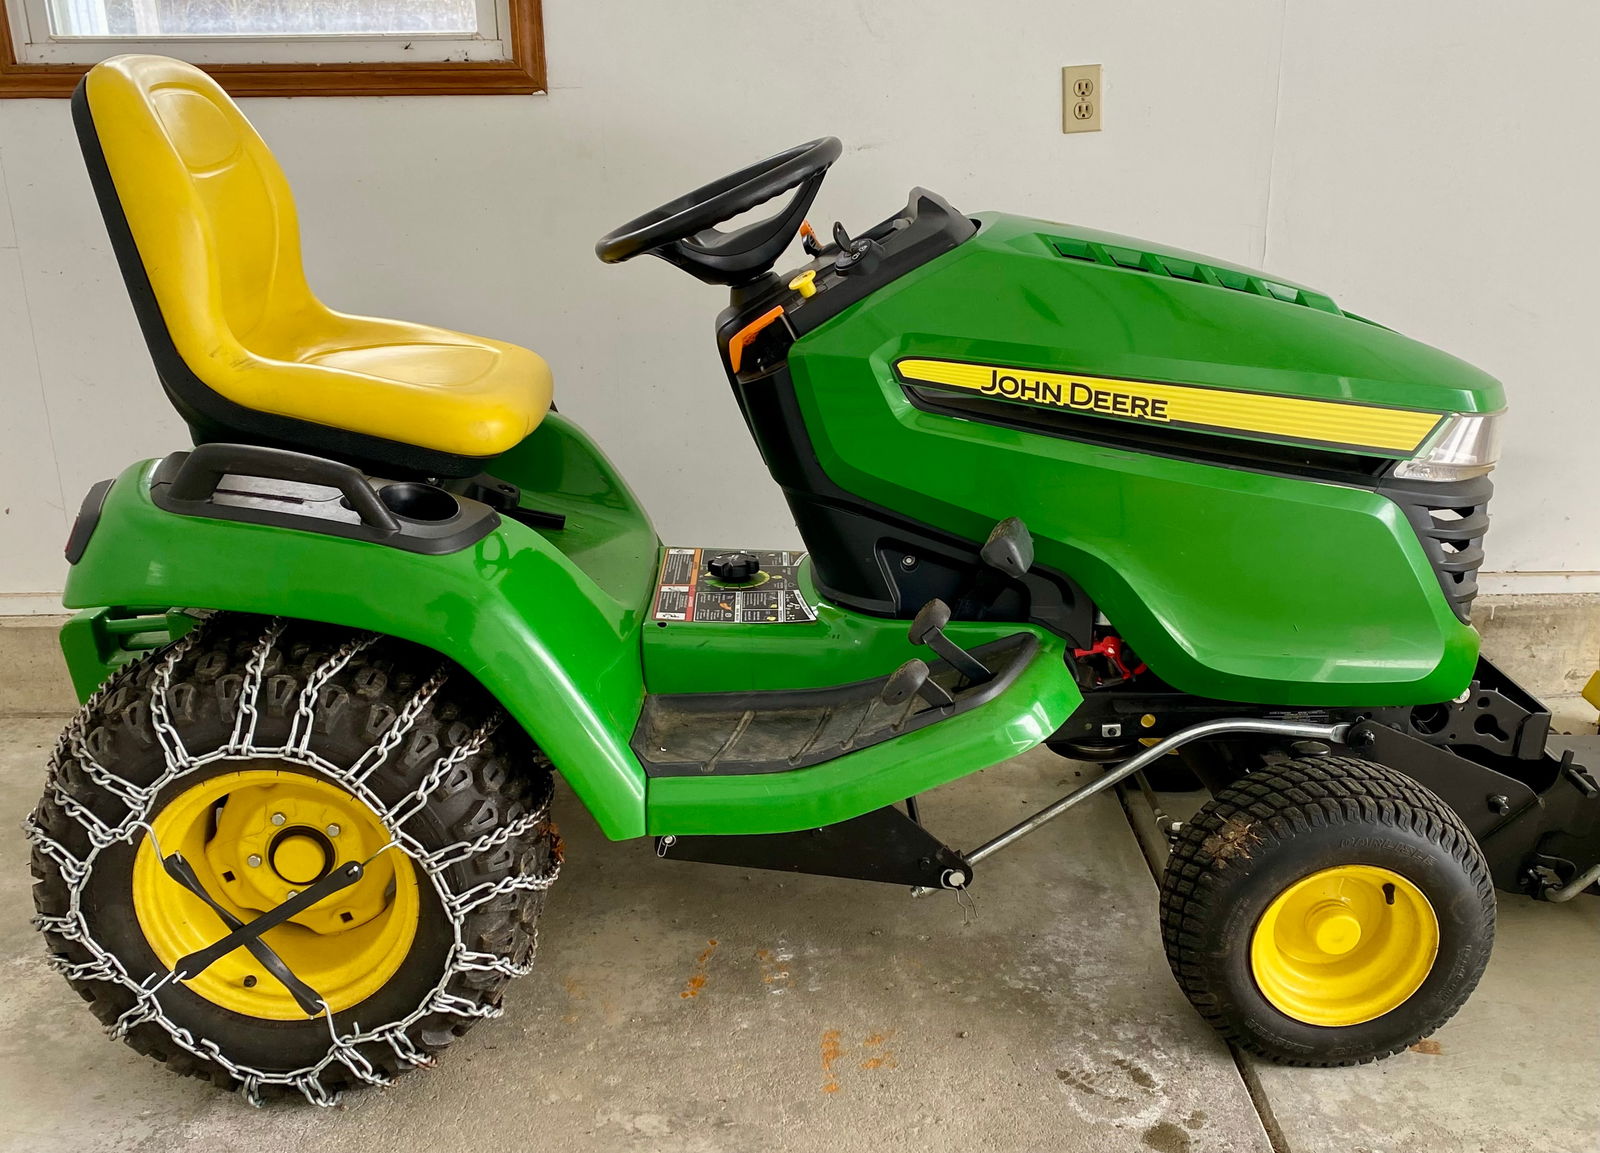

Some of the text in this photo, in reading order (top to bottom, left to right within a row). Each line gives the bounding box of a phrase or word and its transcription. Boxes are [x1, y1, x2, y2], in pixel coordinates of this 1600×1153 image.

[981, 370, 1168, 419] JOHN DEERE
[1339, 836, 1438, 866] CARLISLE
